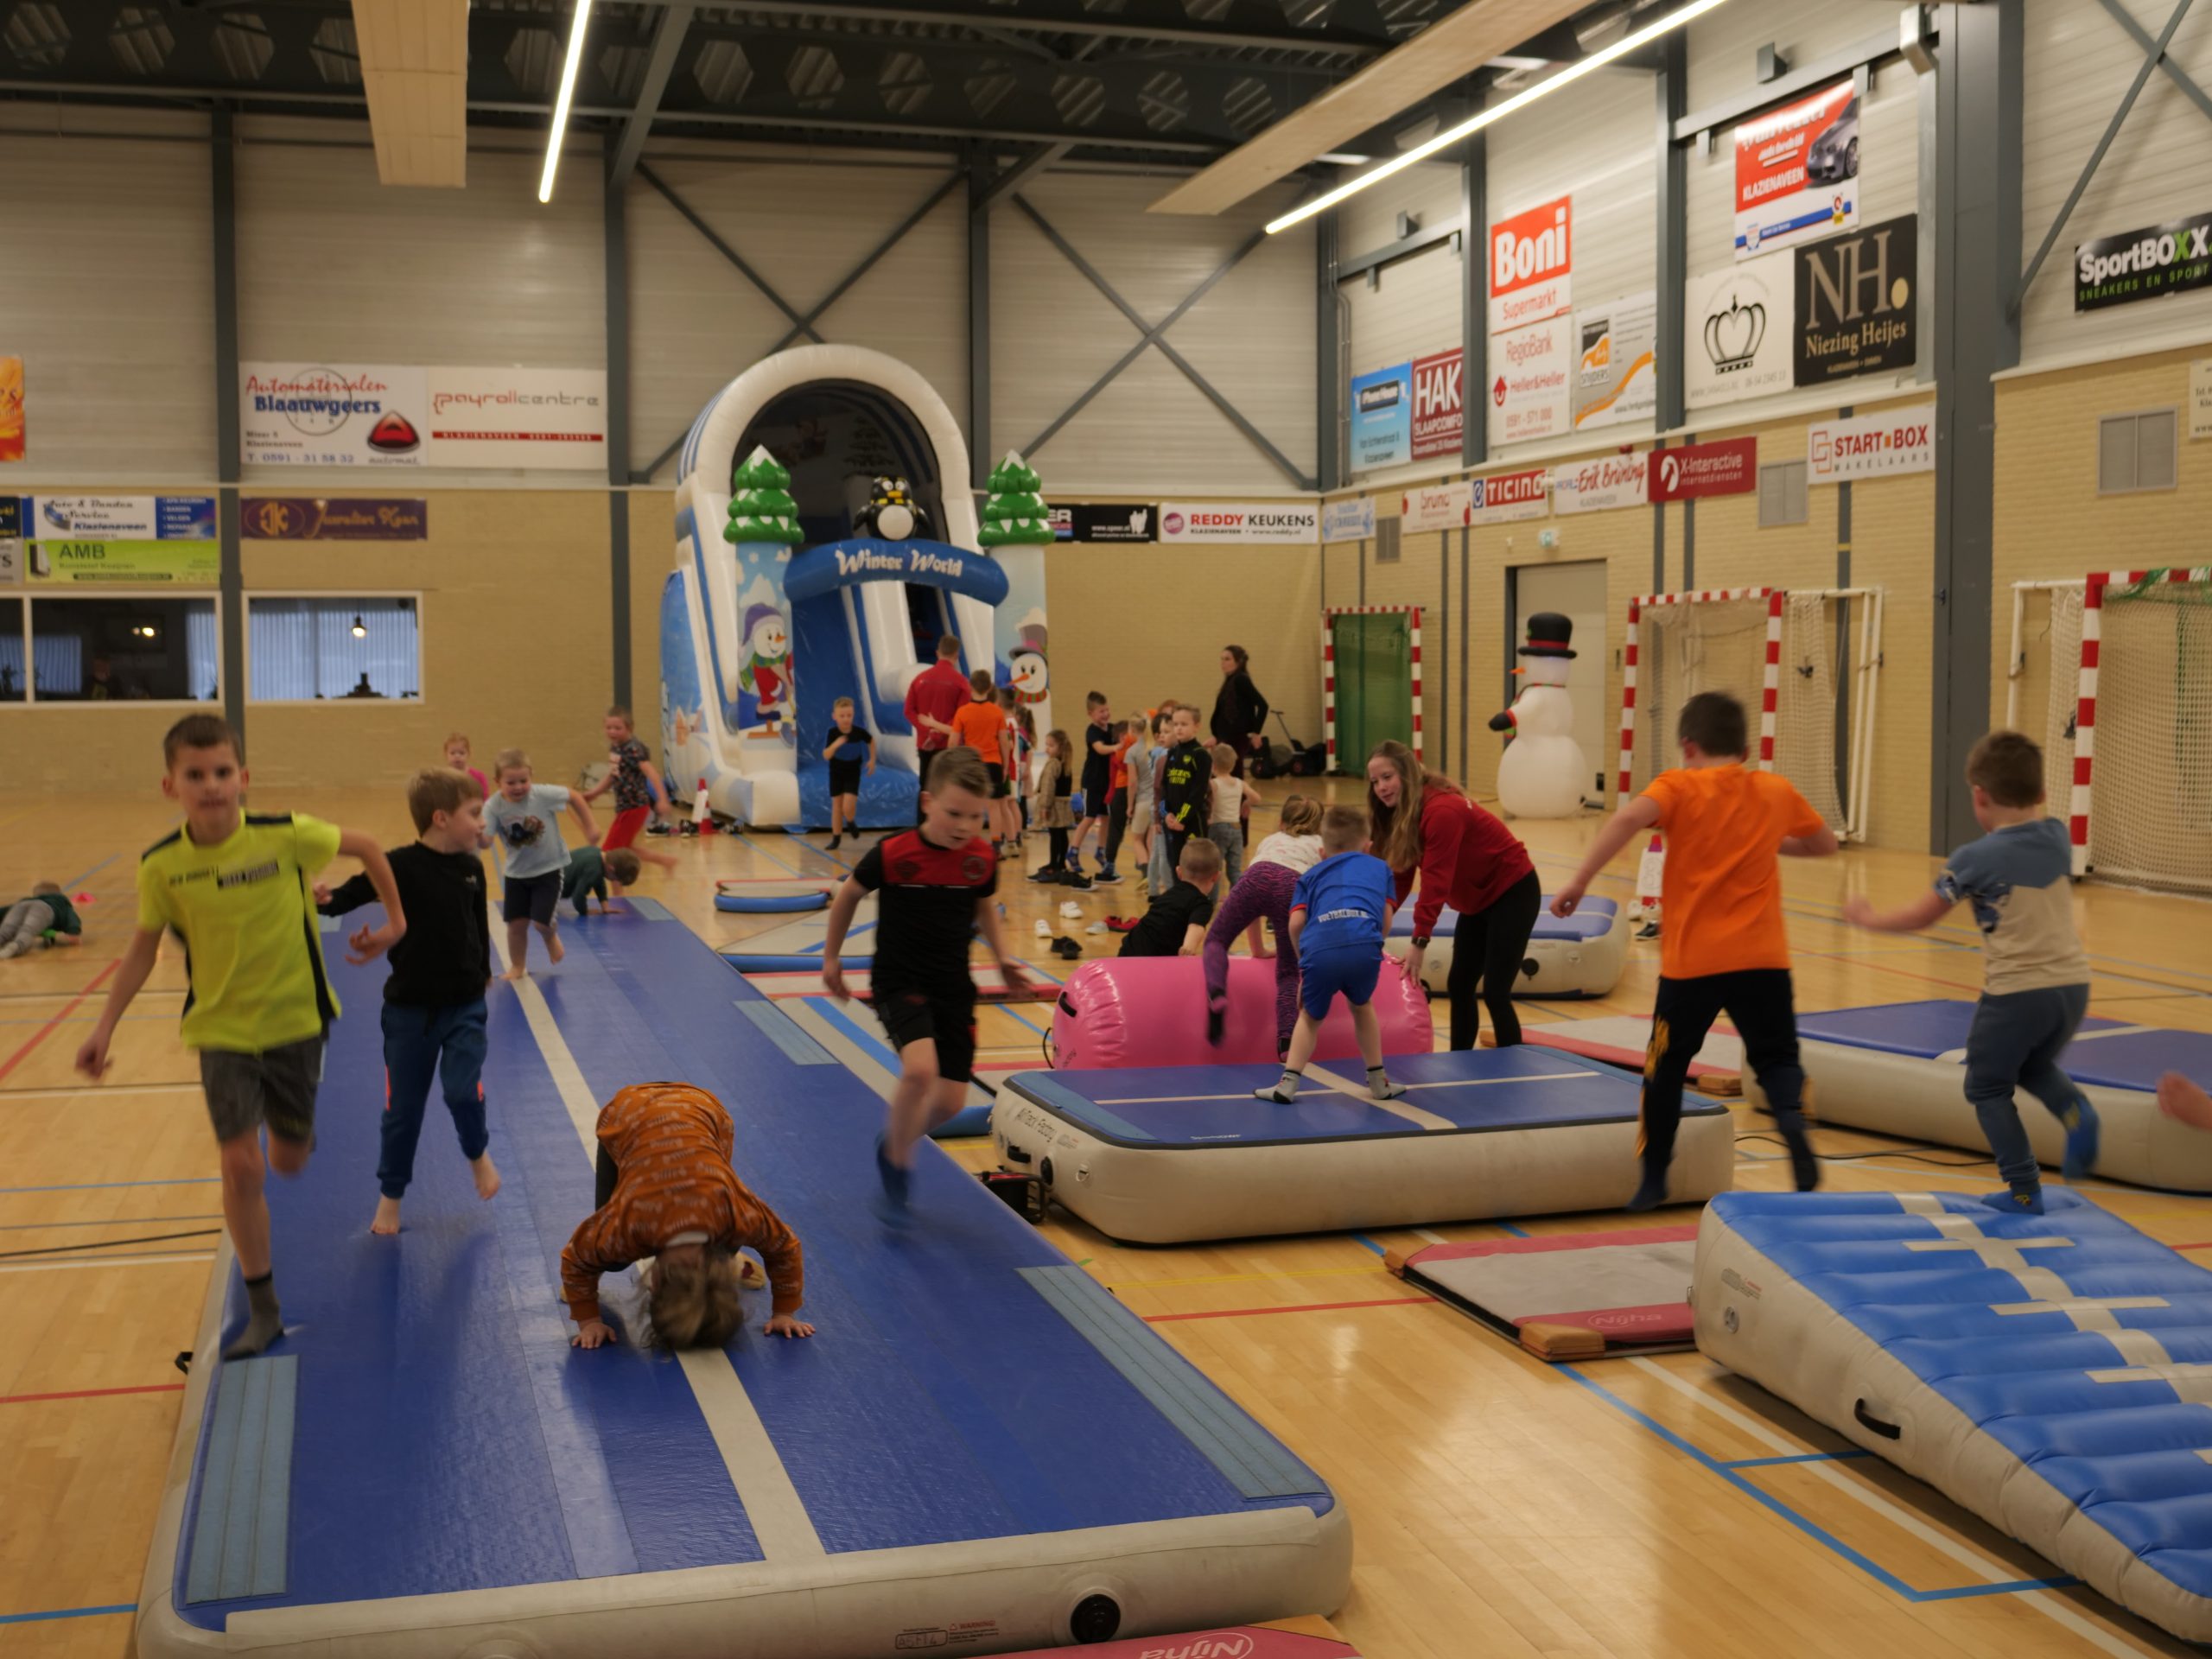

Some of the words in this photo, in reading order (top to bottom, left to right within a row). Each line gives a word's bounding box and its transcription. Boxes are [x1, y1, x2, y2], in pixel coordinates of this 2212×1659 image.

[1742, 166, 1805, 202] KLAZIENAVEEN
[1495, 207, 1566, 288] Boni
[2080, 279, 2139, 302] SNEAKERS
[2146, 274, 2161, 288] EN
[2169, 262, 2209, 283] SPORT
[1503, 289, 1557, 321] Supermarkt
[1506, 329, 1553, 366] RegioBank
[1806, 331, 1859, 358] Niezing
[1861, 320, 1906, 349] Heijes
[245, 373, 388, 396] Automaterialen
[1416, 361, 1462, 418] HAK
[255, 395, 382, 416] Blaauwgeers
[1414, 413, 1463, 435] SLAAPCOMFO
[1835, 431, 1884, 457] START
[1893, 424, 1929, 450] BOX
[1681, 454, 1743, 475] X-Interactive
[1834, 451, 1929, 473] MAKELAARS
[1420, 490, 1451, 511] bruno
[73, 522, 147, 531] Klazienaveen
[1191, 513, 1244, 526] REDDY
[1248, 513, 1314, 526] KEUKENS
[59, 543, 106, 560] AMB
[835, 549, 902, 576] Winter
[910, 549, 963, 577] World
[1595, 1313, 1662, 1325] Nijha
[1139, 1639, 1244, 1659] Nijha
